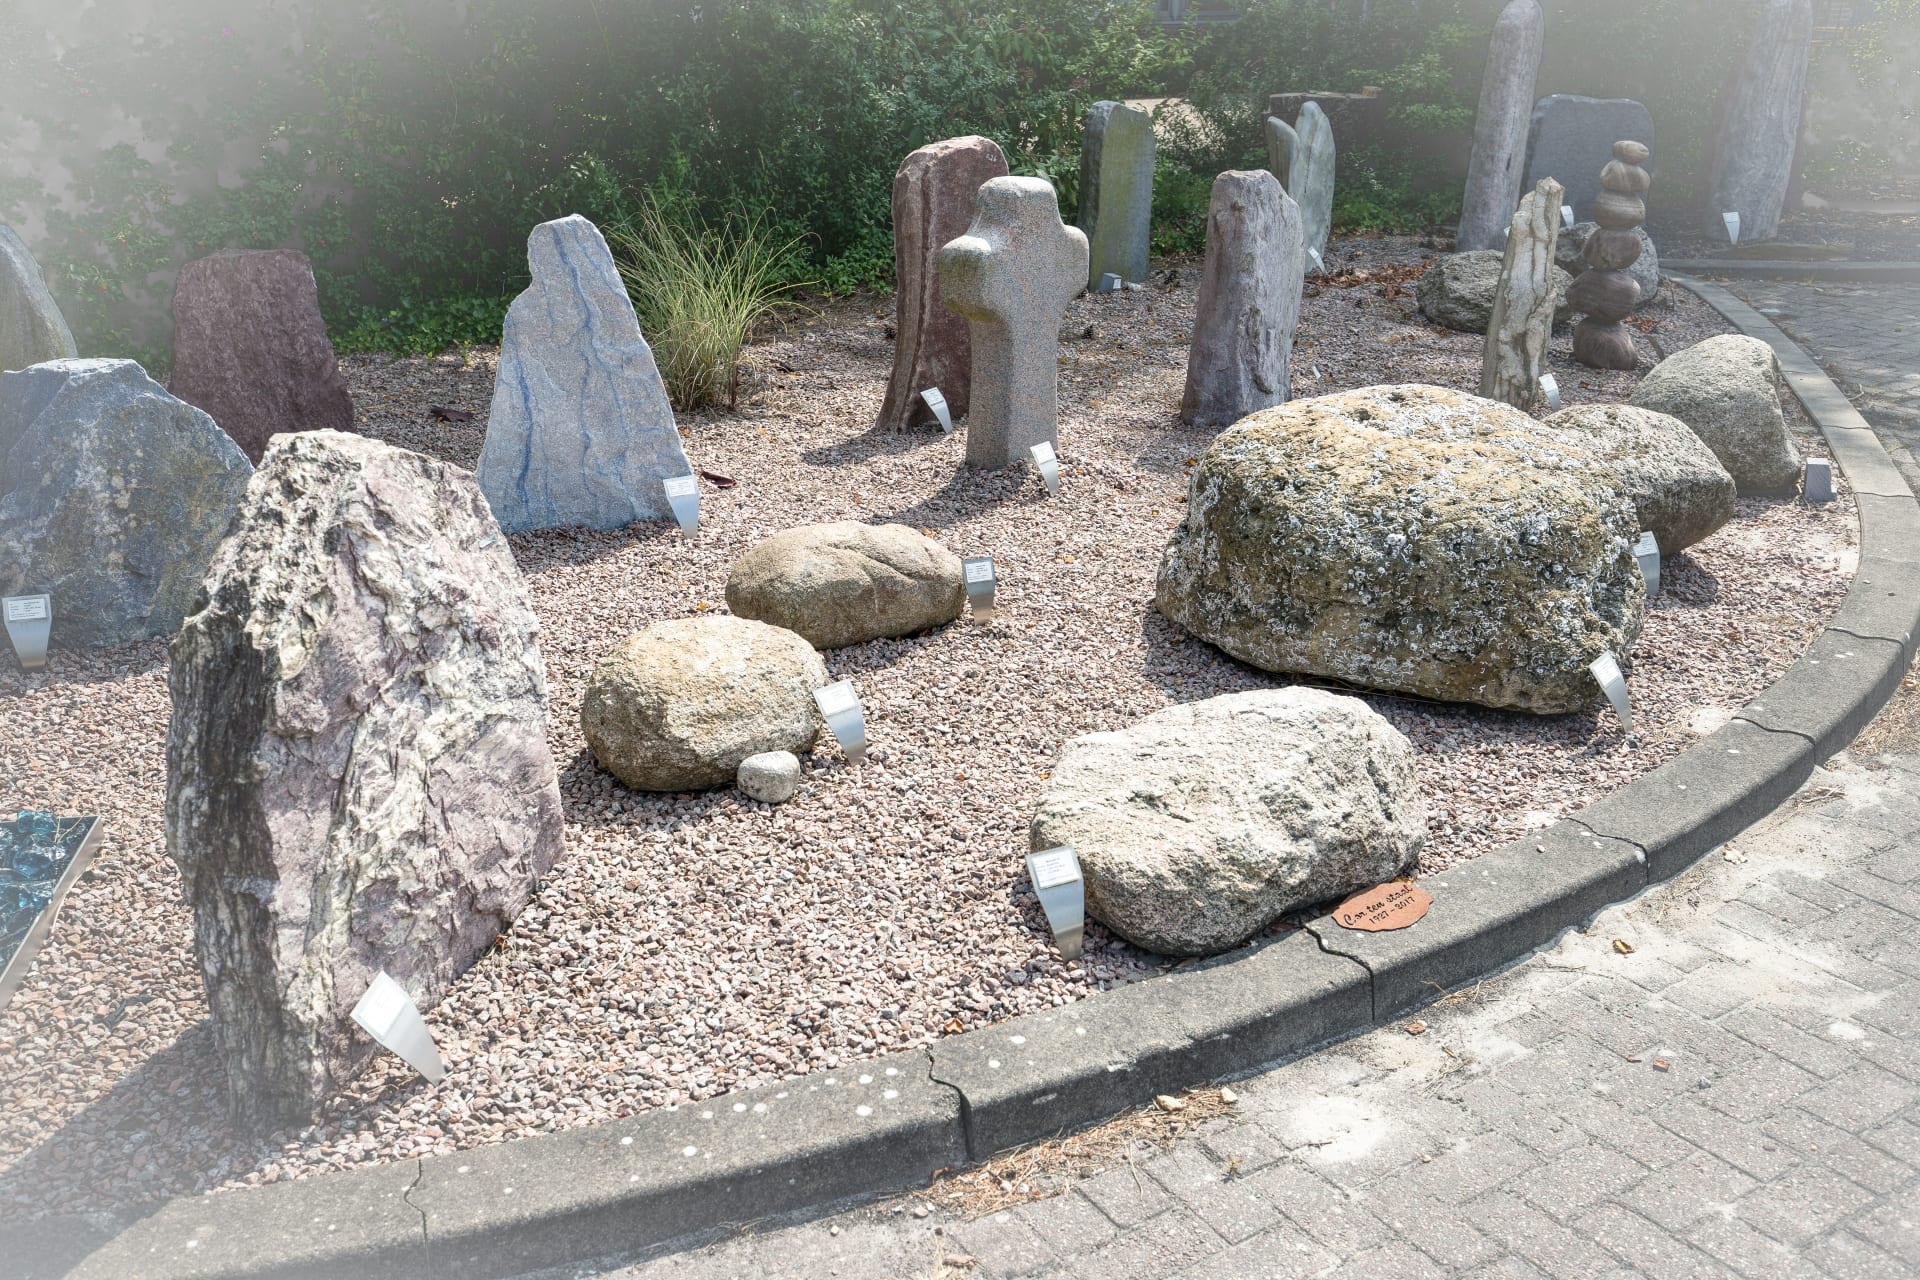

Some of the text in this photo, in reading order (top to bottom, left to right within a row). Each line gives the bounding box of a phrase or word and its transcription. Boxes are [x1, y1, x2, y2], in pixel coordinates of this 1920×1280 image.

[1366, 901, 1385, 912] ten
[1368, 911, 1389, 924] 1927
[1395, 896, 1415, 909] 2017
